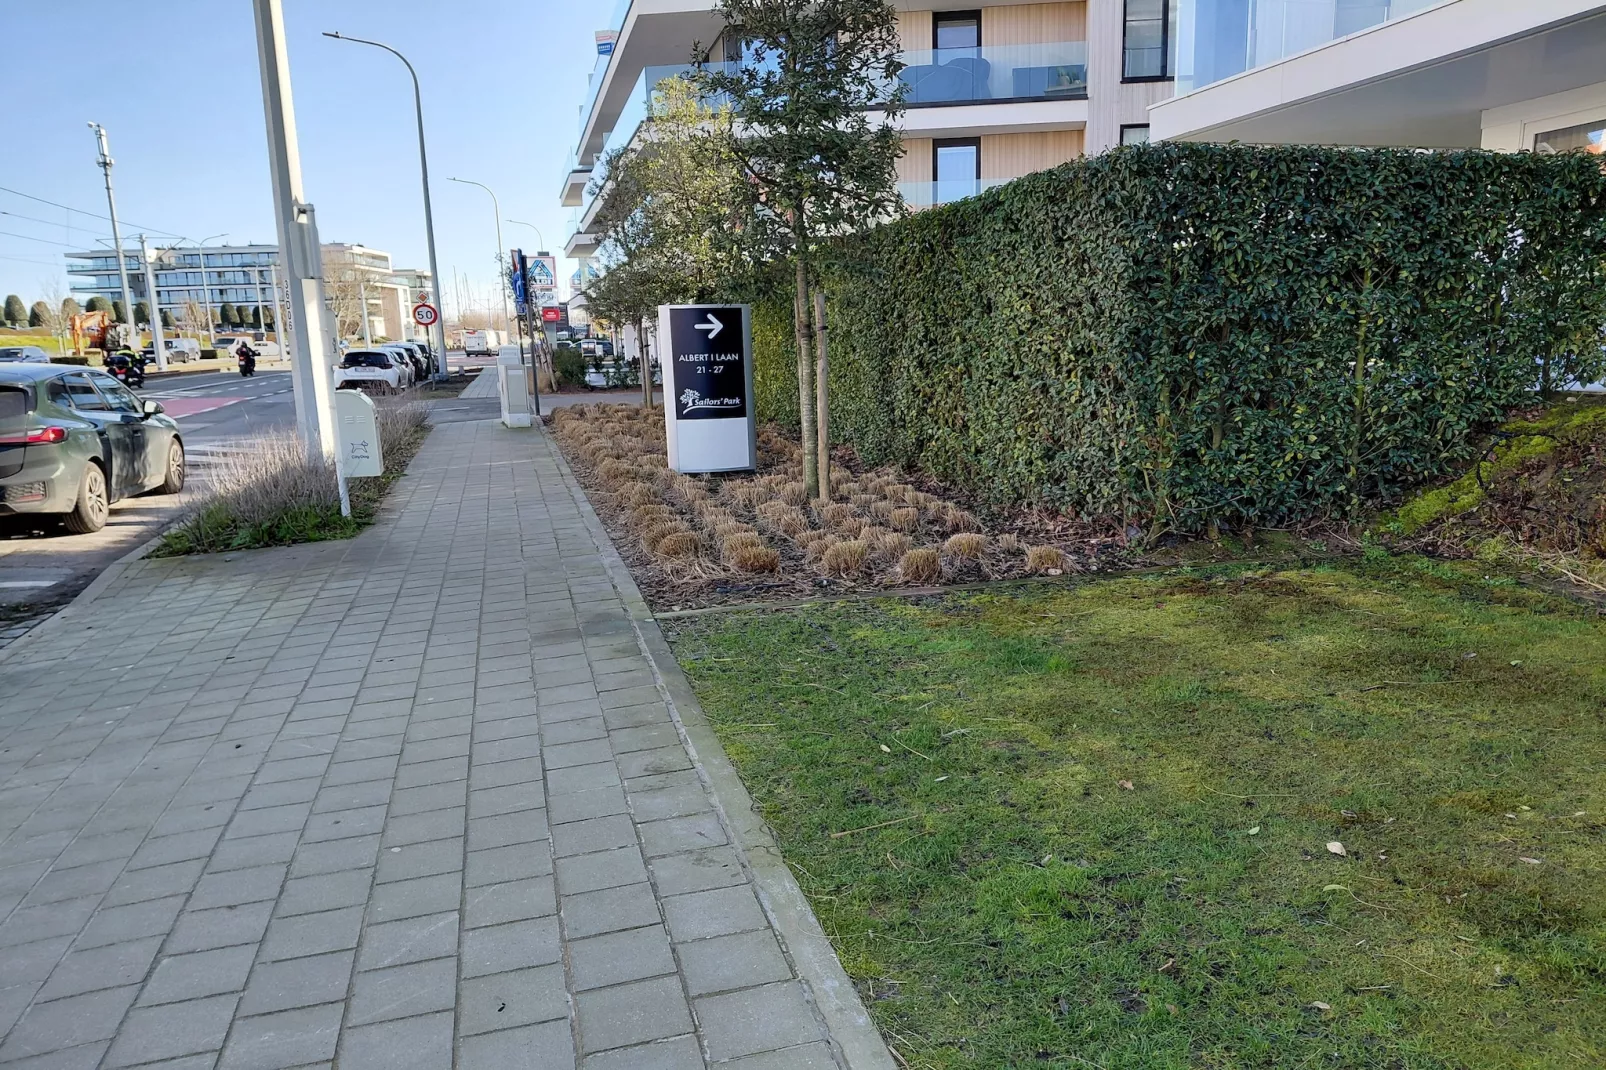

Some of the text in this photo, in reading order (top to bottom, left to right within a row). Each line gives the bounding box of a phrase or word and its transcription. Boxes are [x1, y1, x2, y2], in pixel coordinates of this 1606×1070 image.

[284, 279, 293, 331] 36006
[416, 310, 433, 320] 50
[678, 353, 709, 362] ALBERT
[715, 353, 739, 361] LAAN
[696, 365, 706, 374] 21
[713, 365, 724, 374] 27
[723, 396, 741, 405] Park
